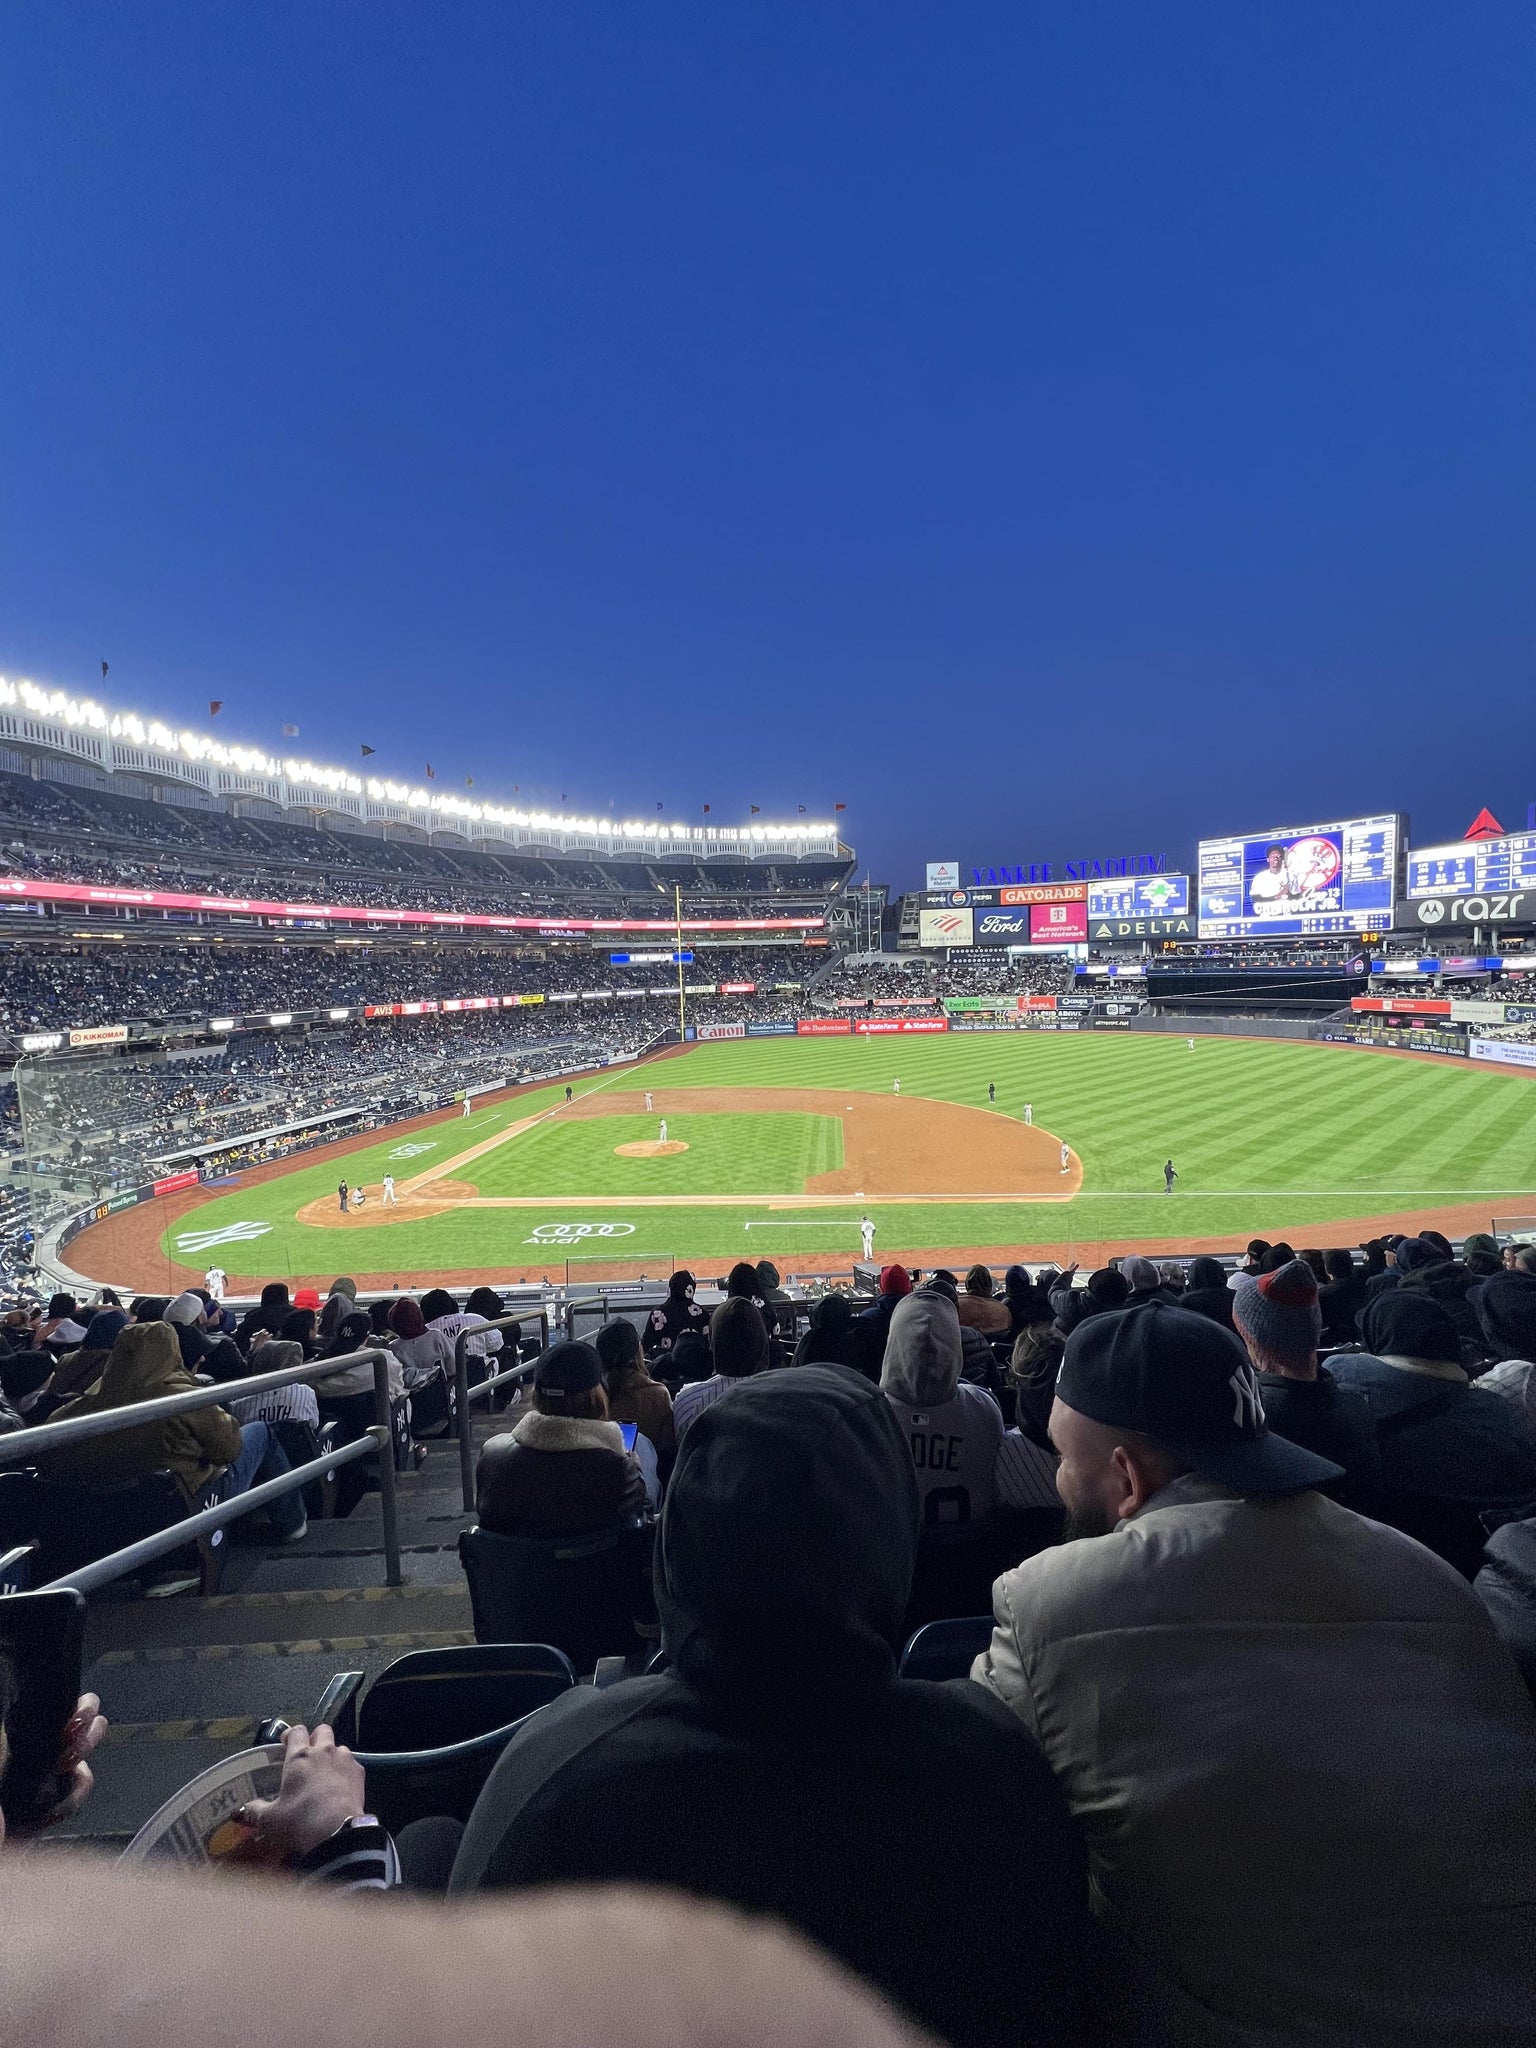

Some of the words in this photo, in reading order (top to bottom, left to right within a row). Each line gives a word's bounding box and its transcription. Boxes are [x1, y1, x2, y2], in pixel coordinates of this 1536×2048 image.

[971, 863, 1054, 886] YANKEE
[1065, 852, 1167, 880] STADIUM
[1005, 887, 1083, 902] GATORADE
[1450, 895, 1524, 921] razr
[980, 915, 1024, 933] Ford
[1118, 920, 1190, 935] DELTA
[374, 1006, 393, 1016] AVIS
[83, 1031, 125, 1041] KIKKOMAN
[698, 1025, 744, 1038] Canon
[522, 1236, 581, 1245] Audi
[258, 1405, 292, 1423] RUTH
